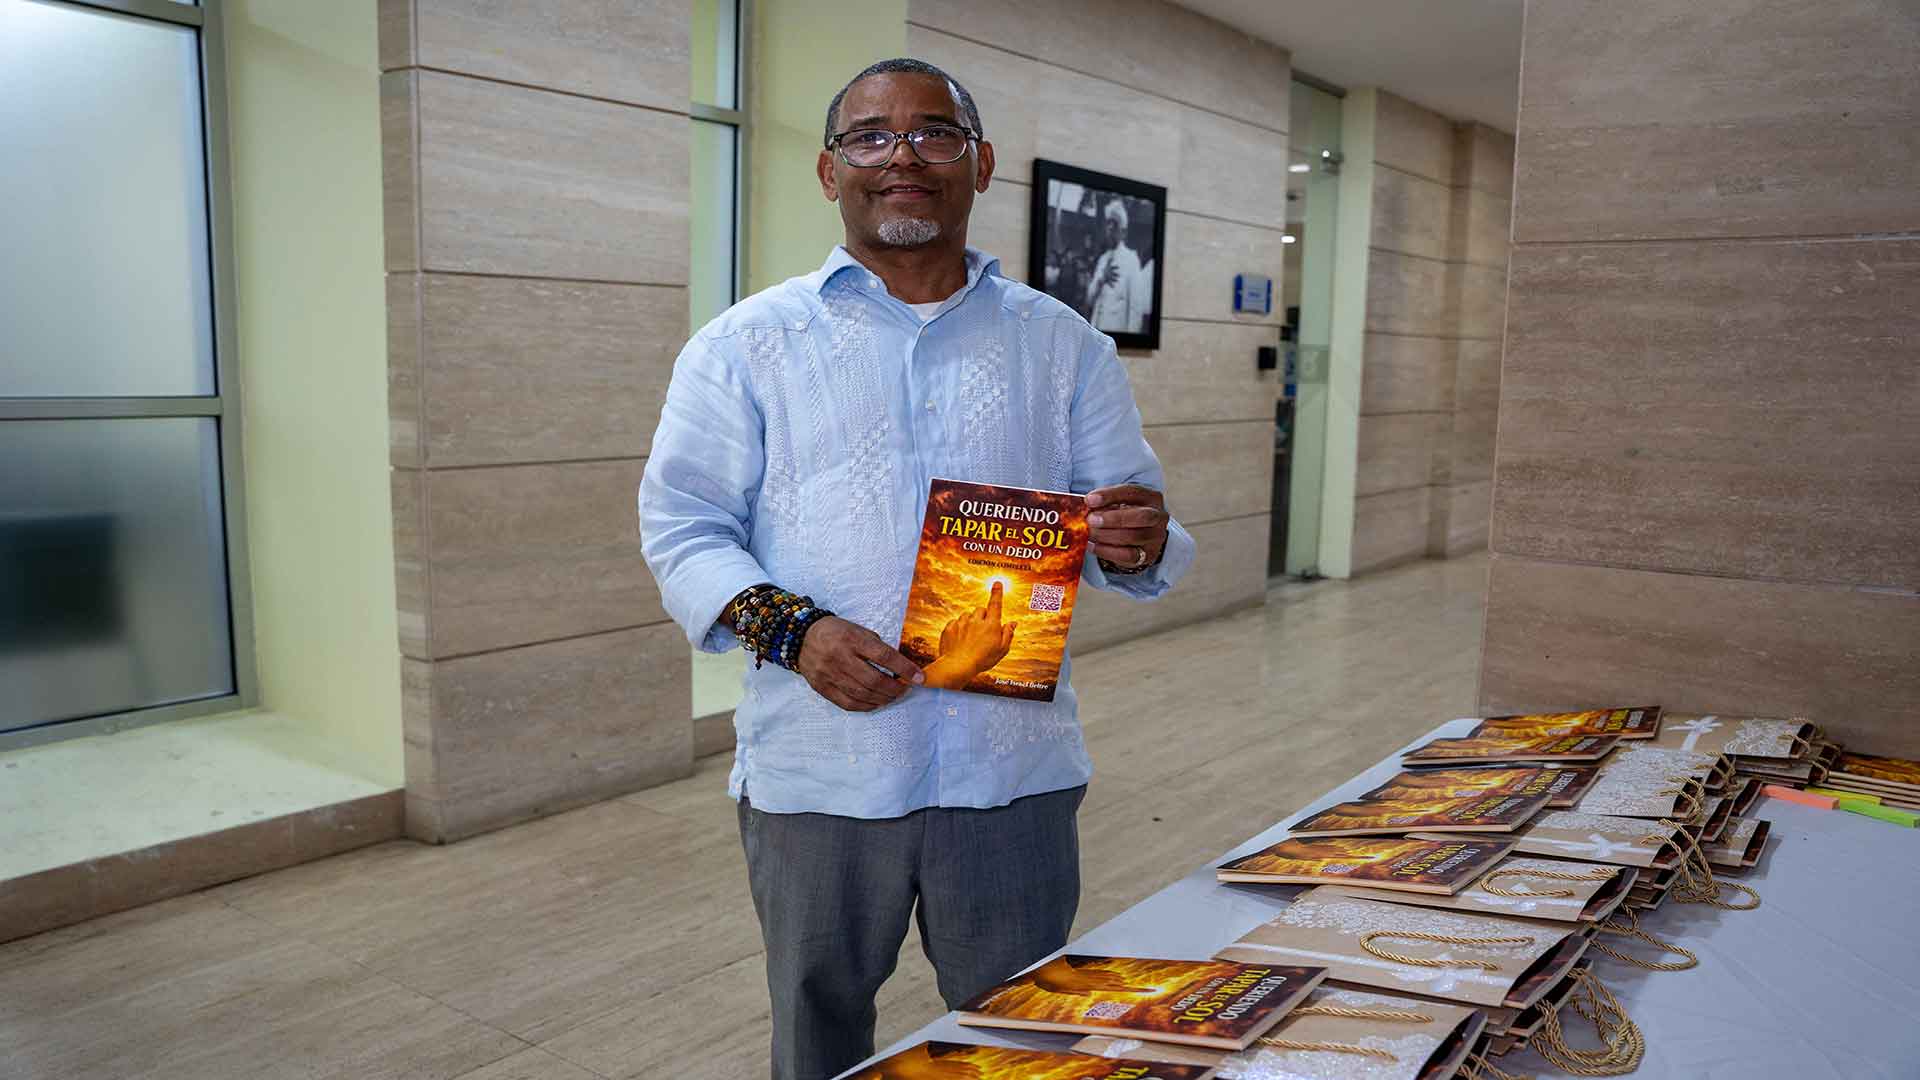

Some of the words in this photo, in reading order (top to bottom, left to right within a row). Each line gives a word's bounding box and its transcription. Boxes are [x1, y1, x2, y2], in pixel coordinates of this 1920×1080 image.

[959, 500, 1059, 524] QUERIENDO
[940, 516, 1002, 541] TAPAR
[1005, 528, 1019, 539] EL
[1021, 526, 1069, 549] SOL
[963, 541, 986, 553] CON
[988, 544, 1003, 554] UN
[1006, 546, 1042, 560] DEDO
[1219, 968, 1271, 995] TAPAR
[1217, 975, 1287, 1020] QUERIENDO
[1173, 1000, 1224, 1024] SOL
